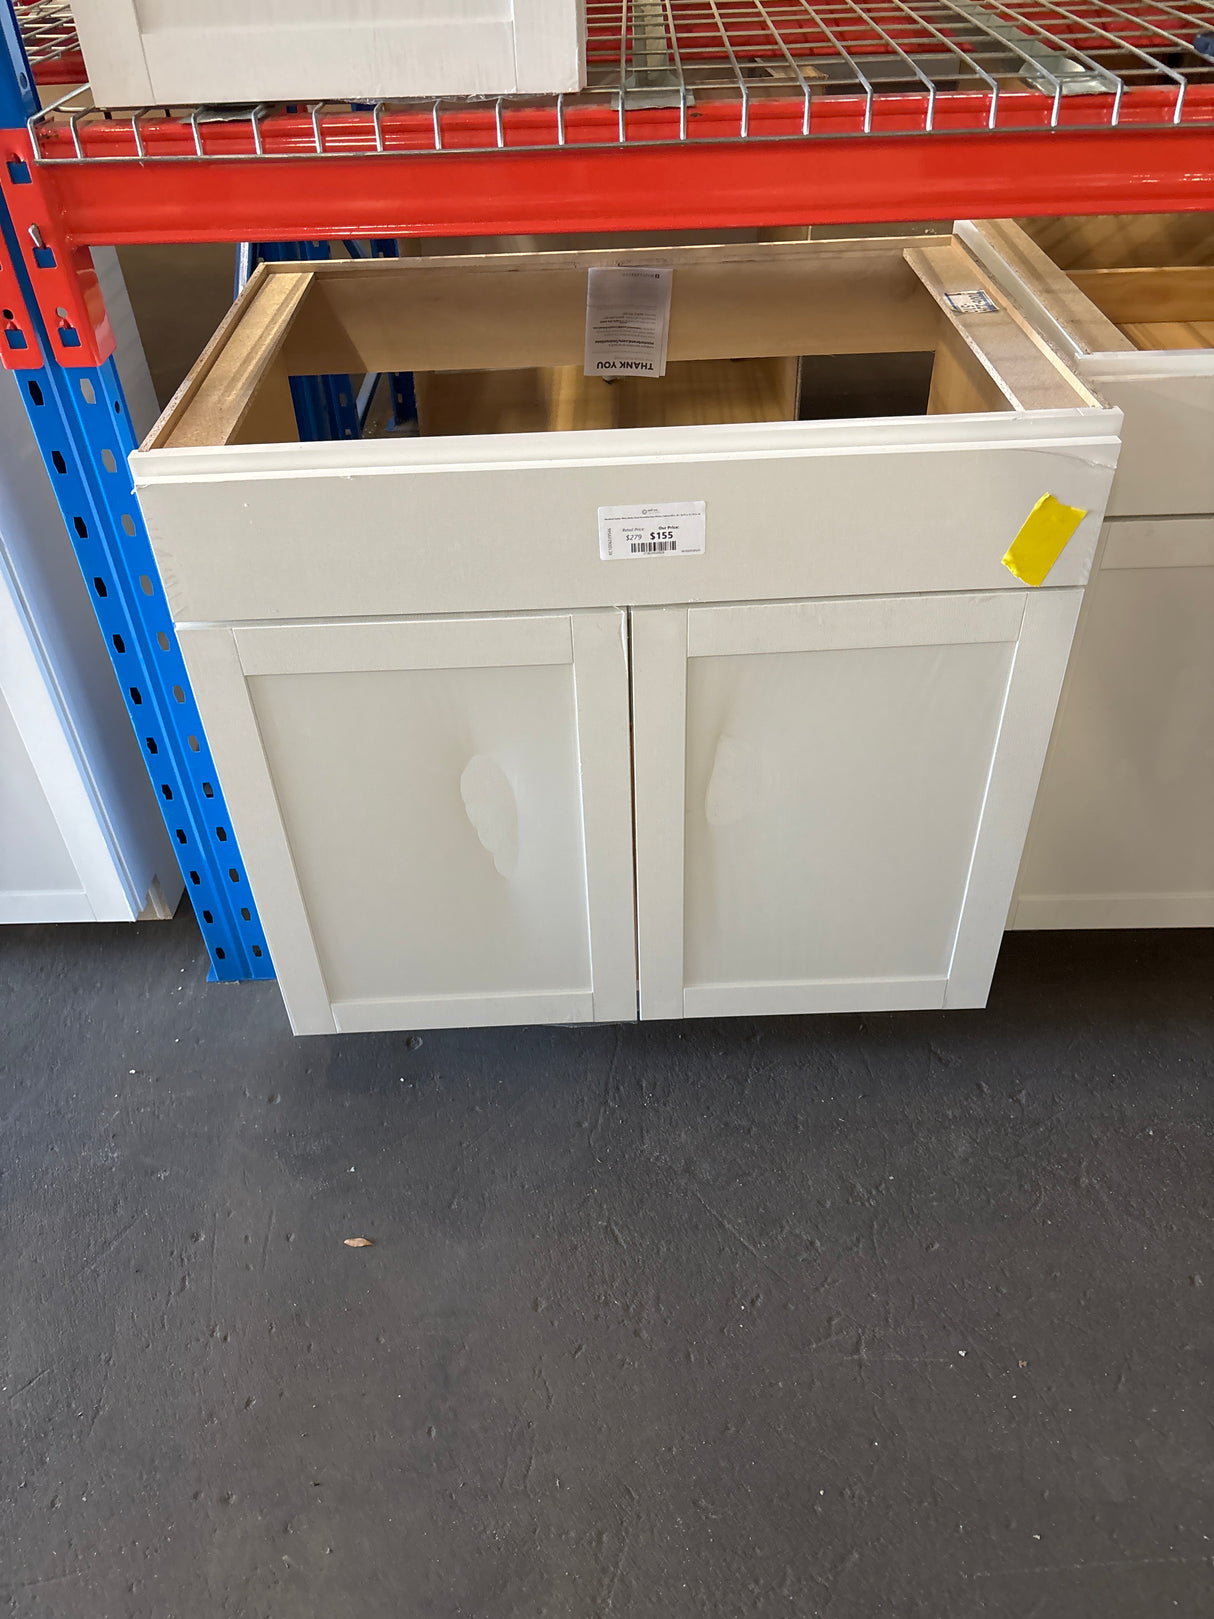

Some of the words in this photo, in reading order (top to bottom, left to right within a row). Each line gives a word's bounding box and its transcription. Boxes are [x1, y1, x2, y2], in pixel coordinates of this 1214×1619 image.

[596, 361, 616, 370] YOU
[619, 361, 654, 370] THANK
[650, 531, 673, 540] $155
